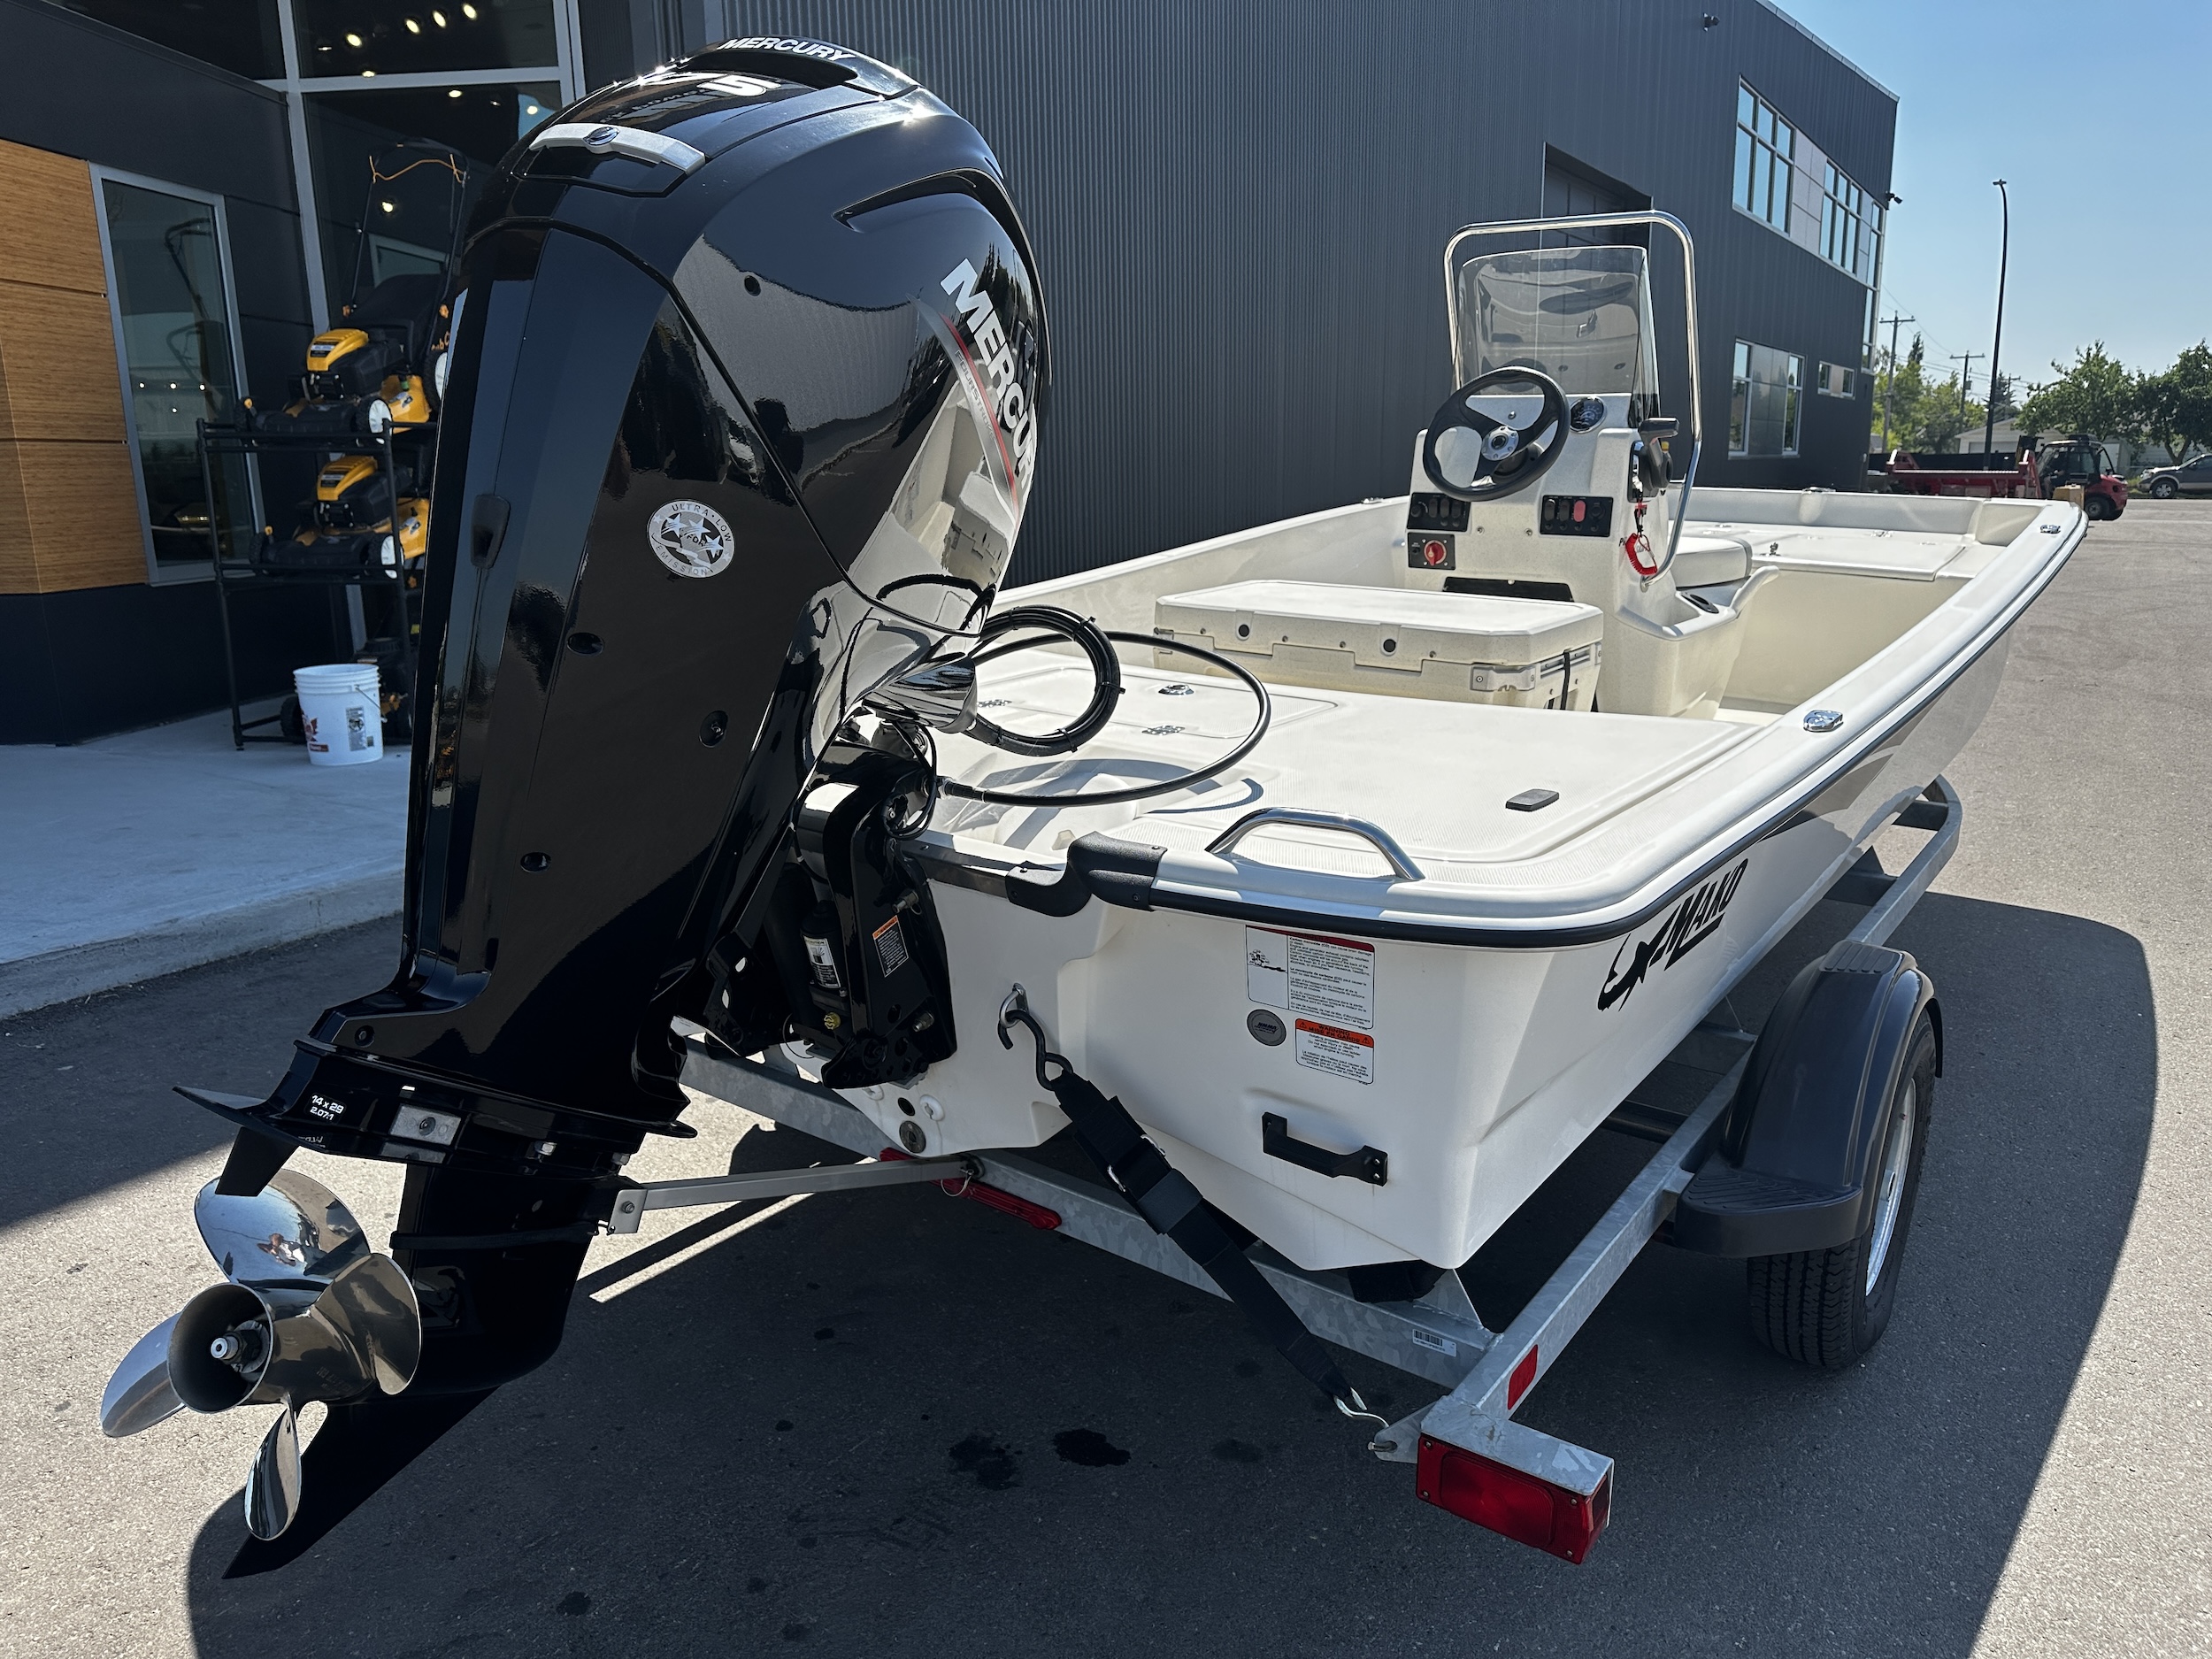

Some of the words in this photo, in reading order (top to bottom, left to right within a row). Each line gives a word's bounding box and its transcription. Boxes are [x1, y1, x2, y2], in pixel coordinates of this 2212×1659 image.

[716, 37, 856, 61] MERCURY
[941, 257, 1037, 503] MERCUR
[671, 503, 710, 517] ULTRA
[715, 518, 733, 542] LOW
[655, 543, 709, 576] EMISSION
[1318, 1025, 1349, 1035] WARNING
[310, 1106, 334, 1121] 2.07:1
[311, 1094, 324, 1105] 14
[328, 1102, 344, 1114] 29
